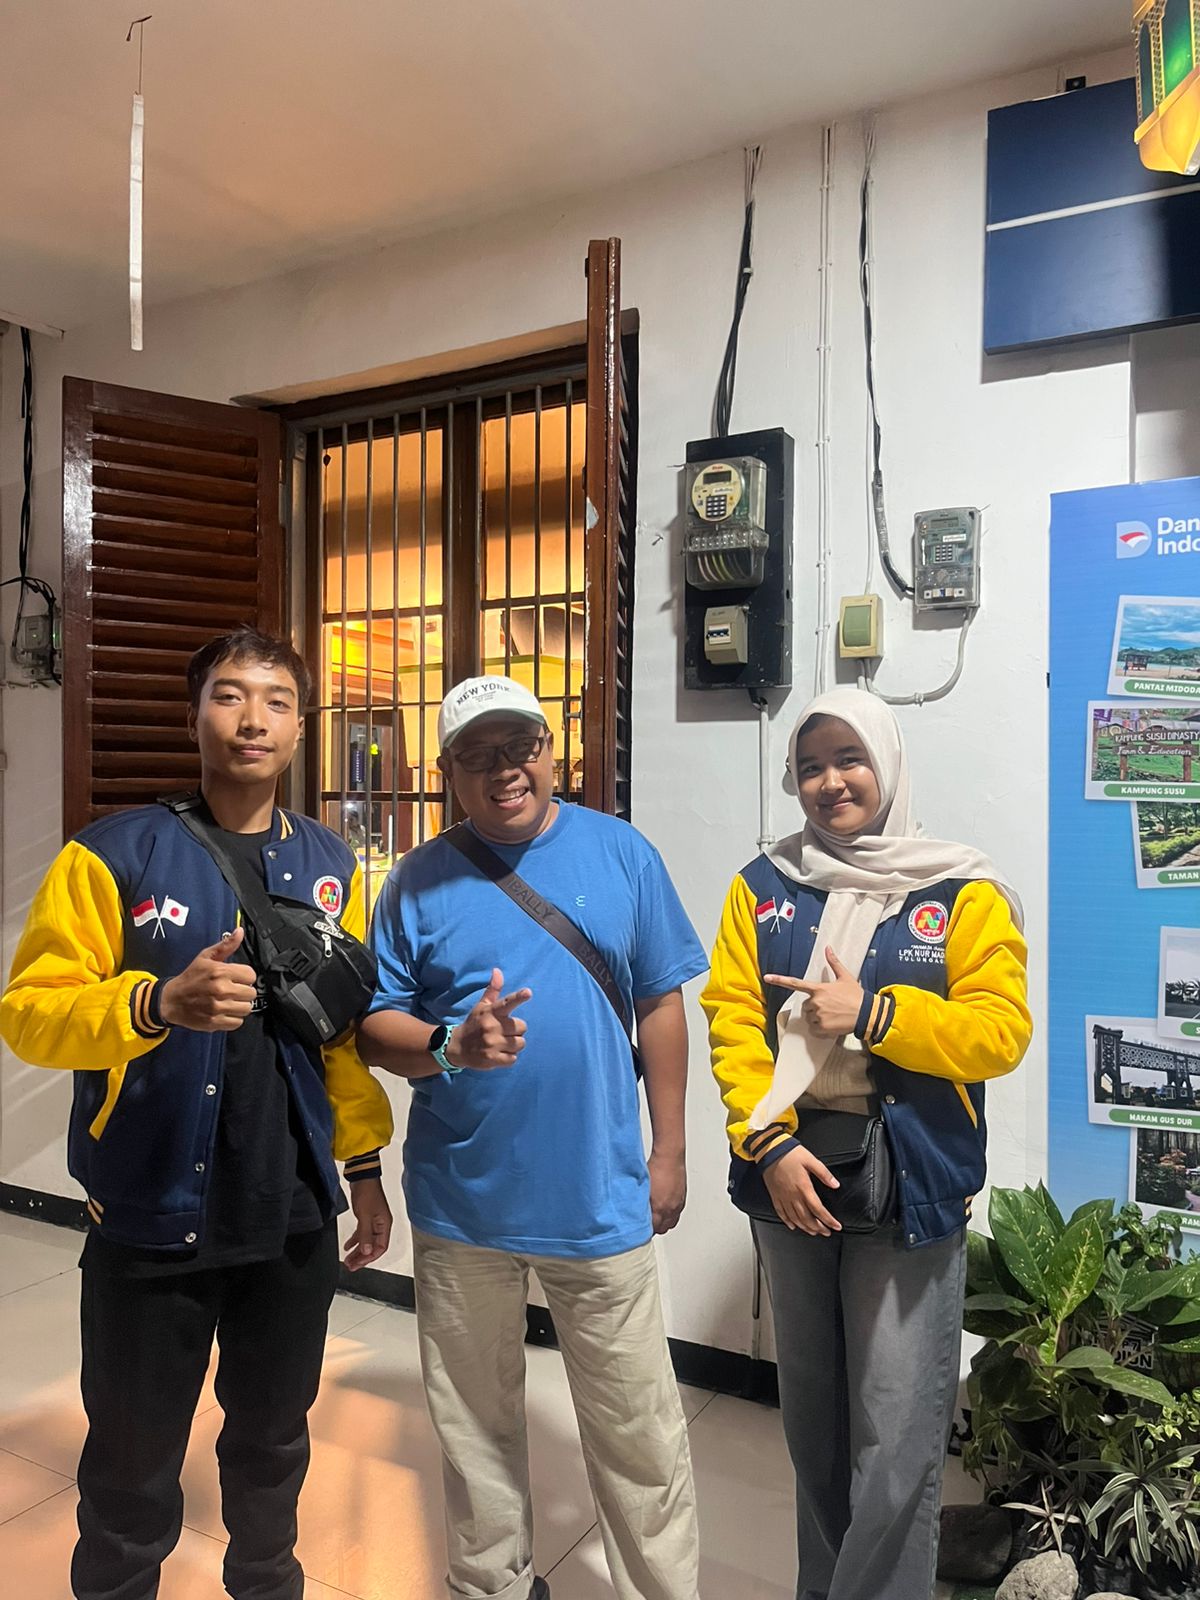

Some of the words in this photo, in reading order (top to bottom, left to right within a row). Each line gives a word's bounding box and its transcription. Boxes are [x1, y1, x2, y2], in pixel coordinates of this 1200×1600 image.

[1134, 682, 1164, 691] PANTAI
[456, 687, 478, 705] NEW
[1164, 787, 1186, 795] SUSU
[1167, 872, 1200, 881] TAMAN
[898, 949, 914, 957] LPK
[1129, 1113, 1158, 1123] MAKAM
[1159, 1116, 1175, 1124] GUS
[1176, 1117, 1193, 1126] DUR
